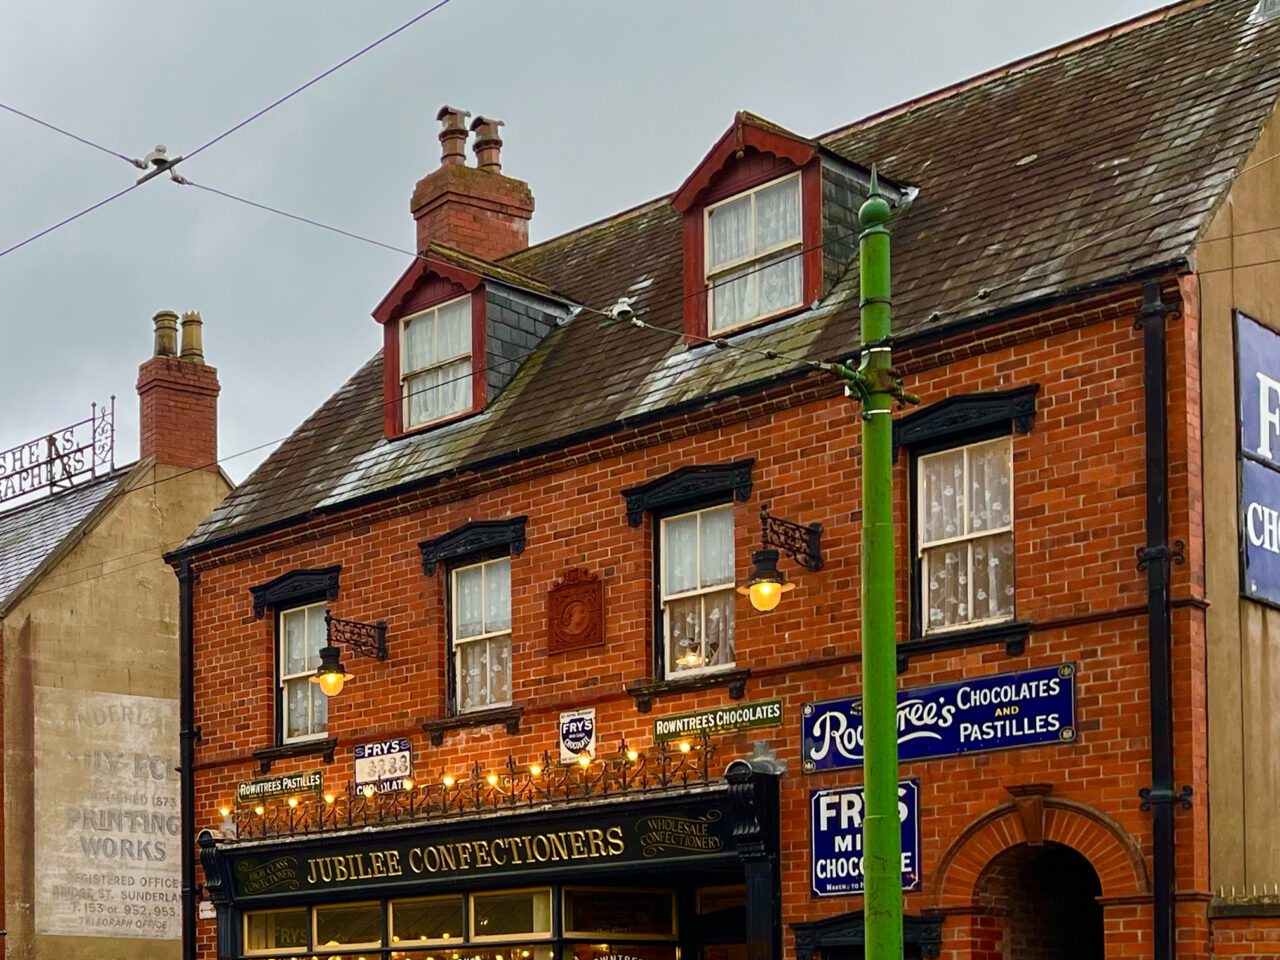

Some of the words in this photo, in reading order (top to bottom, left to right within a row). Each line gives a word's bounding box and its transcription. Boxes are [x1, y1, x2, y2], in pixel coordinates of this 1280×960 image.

[1247, 502, 1280, 554] CH
[957, 678, 1061, 710] CHOCOLATES
[656, 712, 715, 735] ROWNTREE'S
[716, 703, 781, 726] CHOCOLATES
[994, 705, 1019, 717] AND
[960, 713, 1061, 742] PASTILLES
[282, 775, 320, 790] PASTILLES
[68, 807, 181, 836] PRINTING
[647, 818, 708, 836] WHOLESALE
[80, 836, 167, 862] WORKS
[640, 830, 721, 850] CONFECTIONERY
[307, 850, 403, 884] JUBILEE
[408, 826, 625, 873] CONFECTIONERS
[816, 852, 912, 879] CHOCE
[121, 890, 182, 903] SUNDERLA
